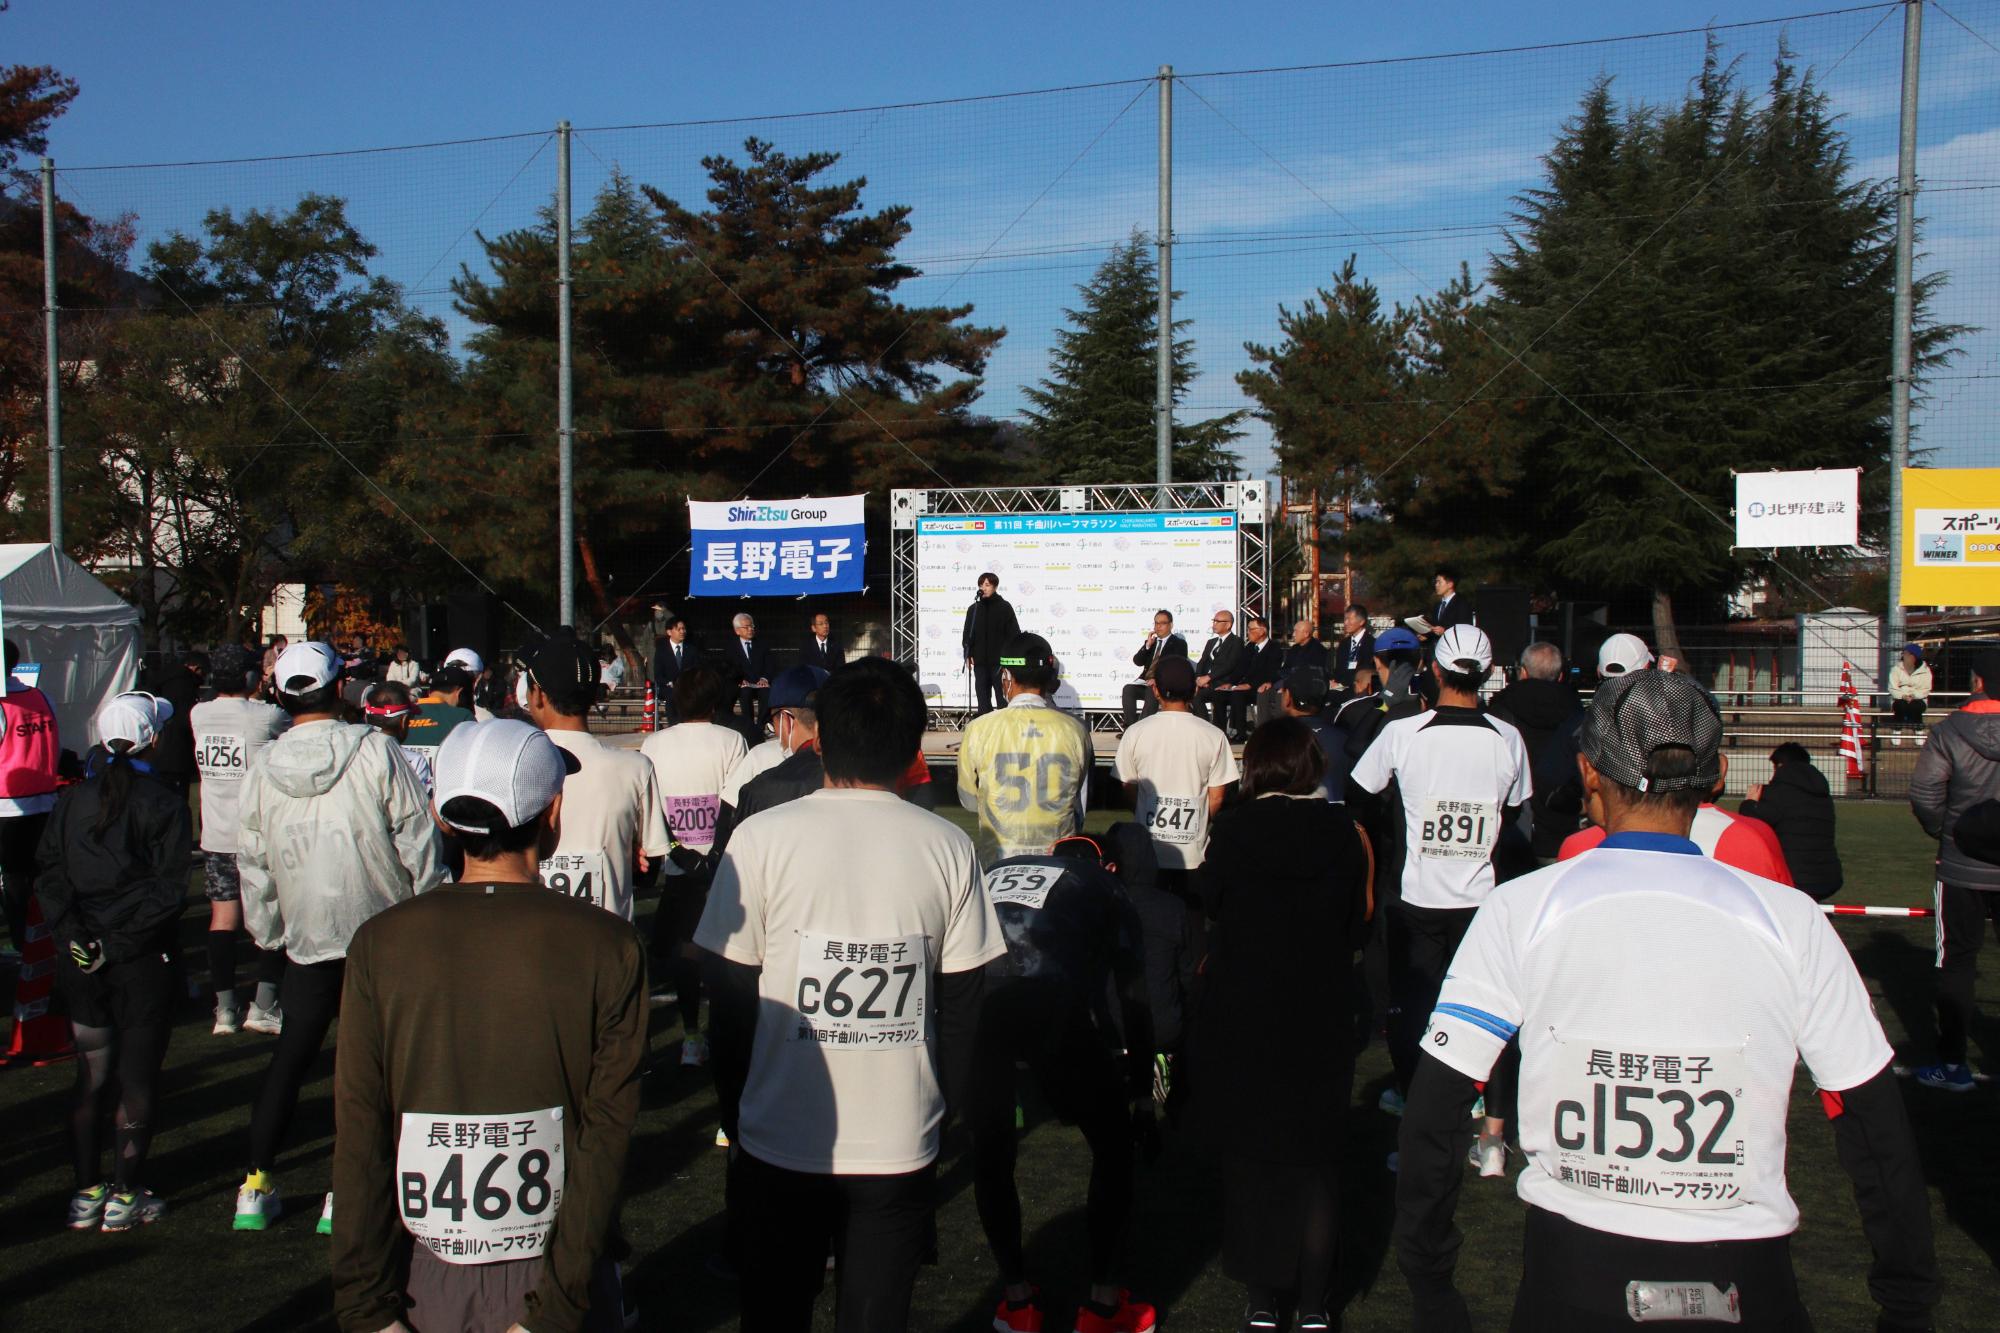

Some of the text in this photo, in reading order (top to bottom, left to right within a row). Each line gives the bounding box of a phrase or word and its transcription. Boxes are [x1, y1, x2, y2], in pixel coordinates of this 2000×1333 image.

[790, 509, 828, 521] Group
[1767, 500, 1846, 516] 北野建設
[993, 520, 1022, 530] 第11回
[1025, 518, 1117, 530] 千曲川ハーフマラソン
[703, 538, 853, 581] 長野電子
[1923, 550, 1958, 559] WINNER
[16, 720, 53, 737] STAFF
[197, 745, 242, 767] B1256
[994, 752, 1072, 812] 50
[669, 806, 717, 832] B2003
[1145, 807, 1196, 831] C647
[1436, 800, 1483, 815] 長野電子
[1422, 813, 1485, 845] B891
[539, 855, 585, 870] 野電子
[540, 871, 595, 902] 94
[988, 873, 1047, 893] 159
[823, 940, 909, 964] 長野電子
[797, 963, 917, 1019] C627
[798, 1026, 920, 1045] 第11回千曲川ハーフマラソン
[1586, 1048, 1714, 1084] 長野電子
[427, 1119, 537, 1149] 長野電子
[1554, 1082, 1736, 1164] C1532
[402, 1148, 551, 1222] B468
[1559, 1165, 1741, 1201] 第11回千曲川ハーフマラソン
[416, 1231, 548, 1256] 11回千曲川ハーフマラソ
